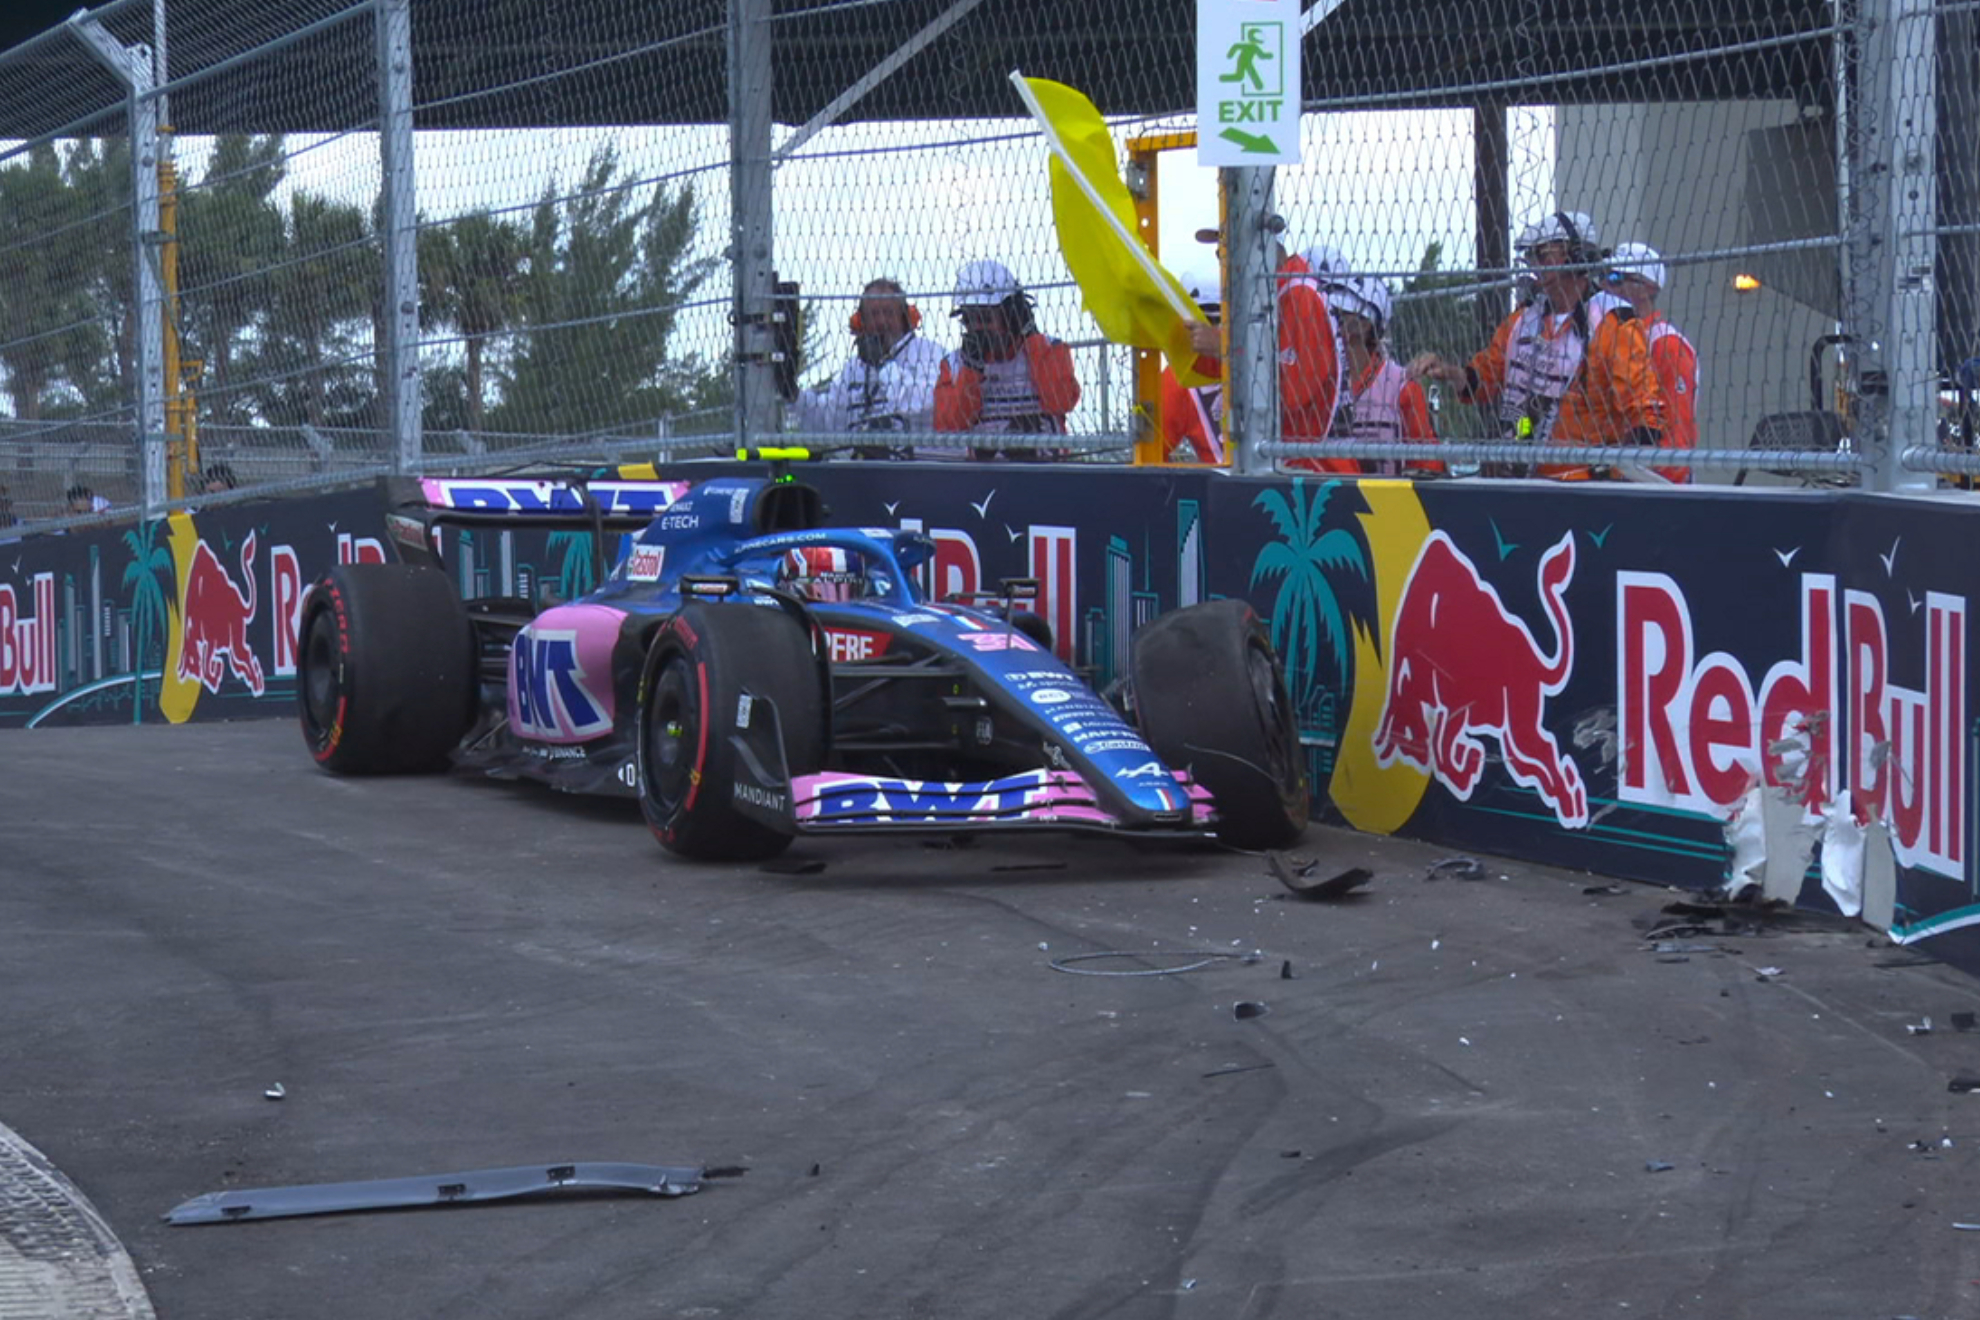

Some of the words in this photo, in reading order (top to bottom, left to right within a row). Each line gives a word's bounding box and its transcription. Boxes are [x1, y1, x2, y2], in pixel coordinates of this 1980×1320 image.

[1218, 100, 1283, 122] EXIT
[661, 515, 699, 530] E-TECH
[0, 571, 56, 694] Bull
[514, 629, 613, 738] BWT
[1617, 570, 1838, 822] Red
[1844, 588, 1966, 882] Bull
[734, 781, 786, 812] MANDIANT
